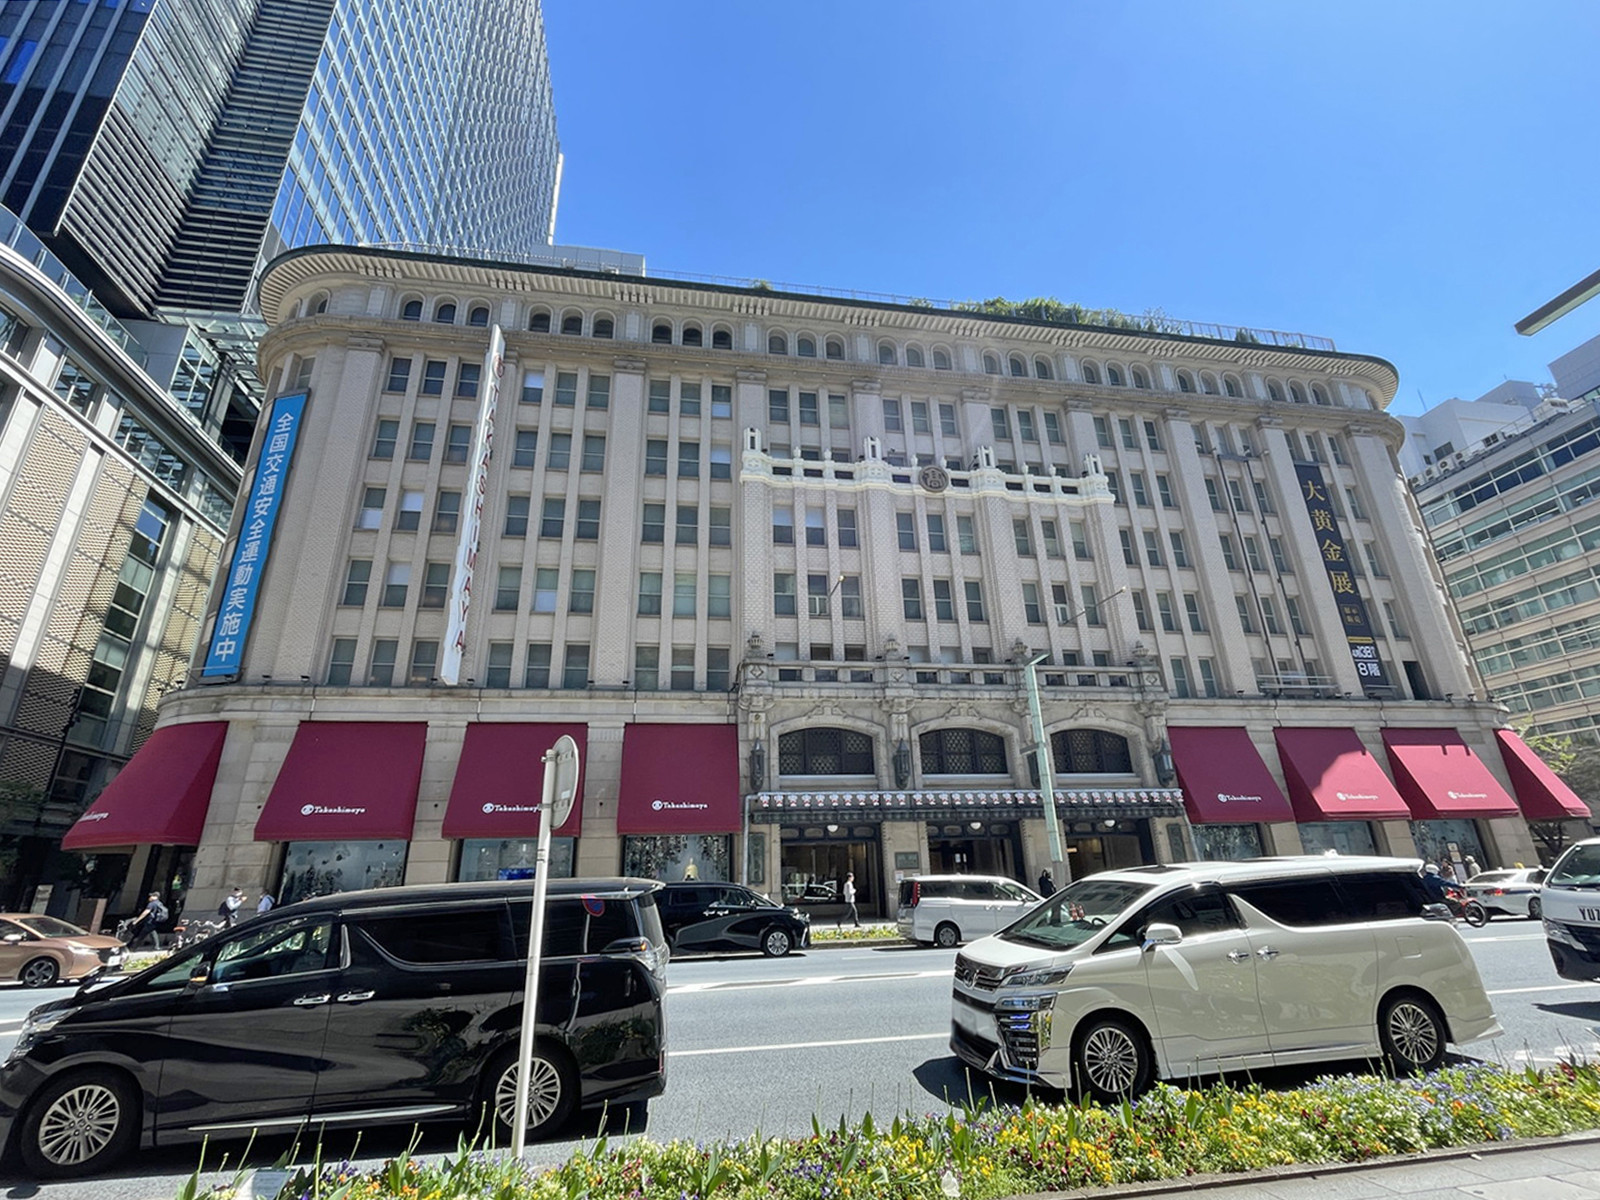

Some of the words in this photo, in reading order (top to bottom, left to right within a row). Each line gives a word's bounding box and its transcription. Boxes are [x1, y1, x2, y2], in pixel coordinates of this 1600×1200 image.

[454, 382, 500, 652] TAKASHIMAYA
[214, 412, 294, 663] 全国交通安全運動実施中
[1302, 479, 1355, 595] 大黄金展
[1358, 662, 1381, 677] 8階
[662, 801, 708, 810] Takashimaya
[1225, 794, 1262, 802] Takashimaya
[314, 806, 366, 815] Takashimaya
